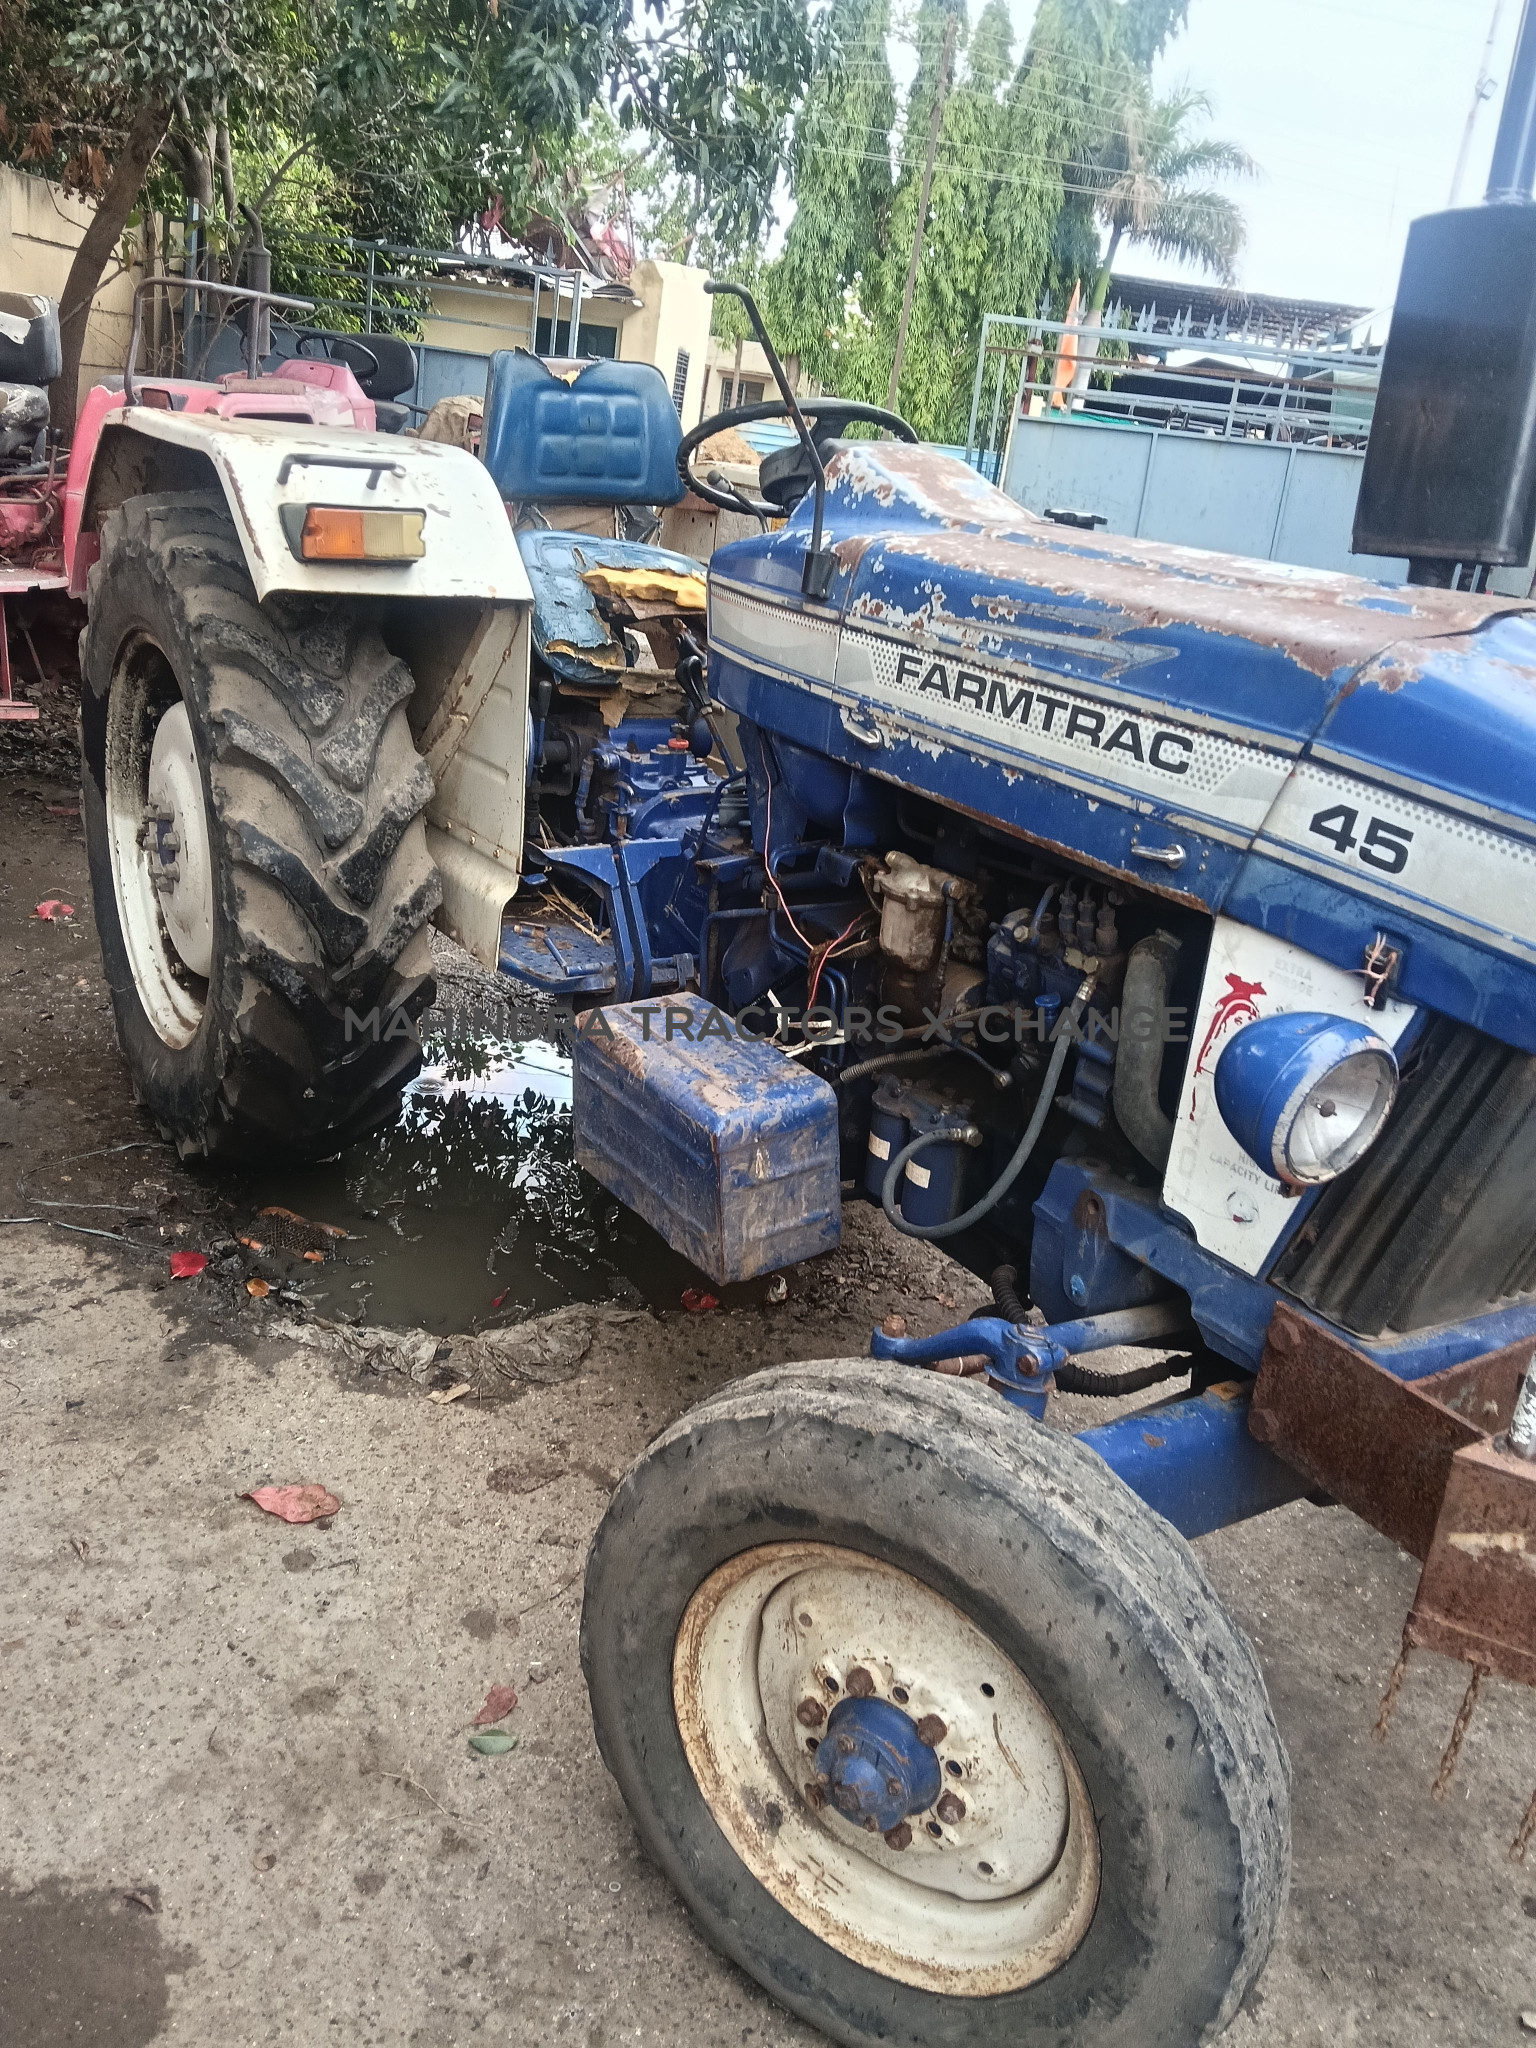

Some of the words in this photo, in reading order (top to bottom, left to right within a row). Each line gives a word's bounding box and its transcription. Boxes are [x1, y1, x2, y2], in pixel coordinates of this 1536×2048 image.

[895, 653, 1194, 774] FARMTRAC
[1309, 804, 1415, 874] 45
[1209, 1151, 1261, 1185] CAPACITY
